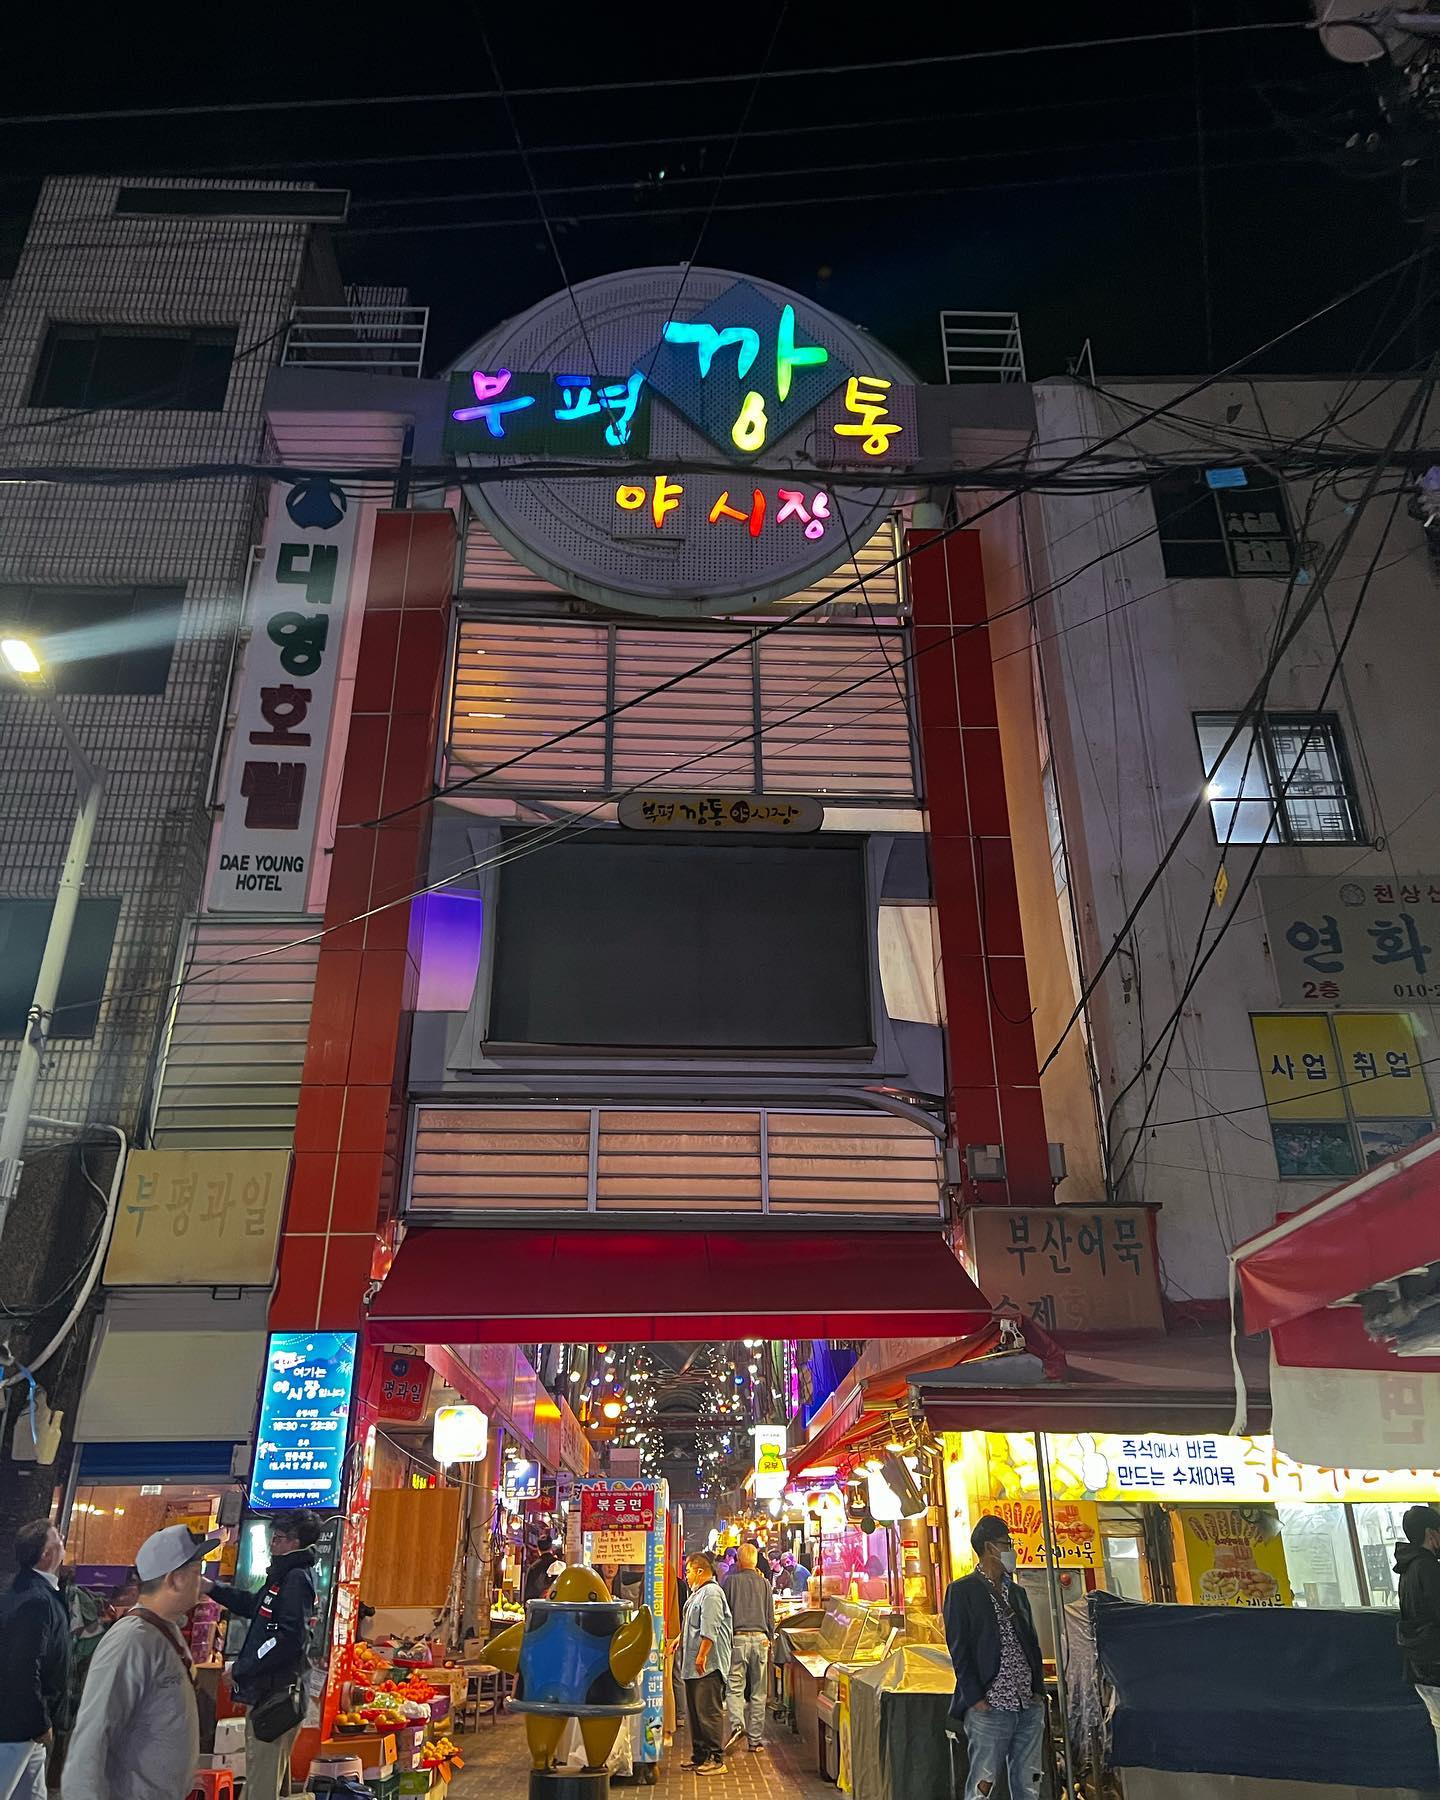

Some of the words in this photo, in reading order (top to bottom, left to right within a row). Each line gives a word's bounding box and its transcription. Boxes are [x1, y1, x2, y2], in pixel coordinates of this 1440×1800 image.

[615, 475, 831, 540] 야시장
[220, 855, 250, 872] DAE
[254, 855, 304, 873] YOUNG
[235, 874, 282, 891] HOTEL
[1286, 913, 1432, 975] 연화
[1303, 981, 1340, 998] 2층
[1271, 1053, 1328, 1080] 사업
[1352, 1051, 1411, 1079] 취업
[1007, 1215, 1144, 1277] 부산어묵
[1122, 1440, 1180, 1459] 즉석에서
[1187, 1440, 1218, 1459] 바로
[1118, 1466, 1165, 1486] 만드는
[1173, 1466, 1236, 1486] 수제어묵
[597, 1498, 641, 1511] 볶음면
